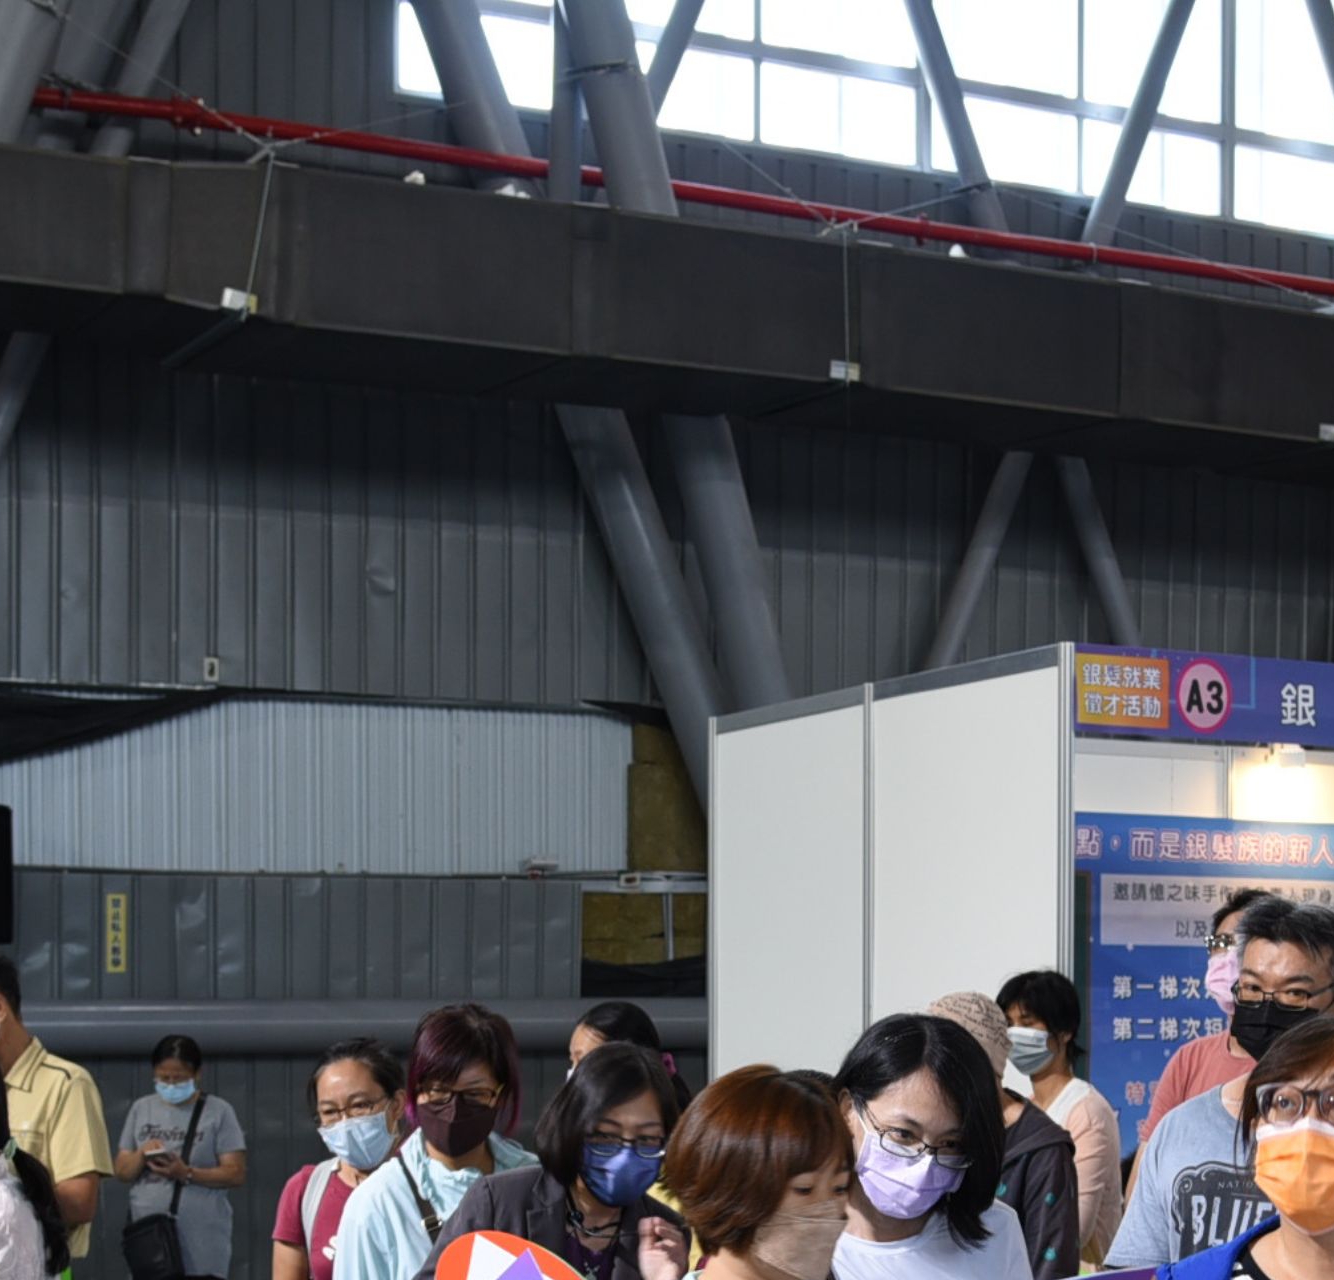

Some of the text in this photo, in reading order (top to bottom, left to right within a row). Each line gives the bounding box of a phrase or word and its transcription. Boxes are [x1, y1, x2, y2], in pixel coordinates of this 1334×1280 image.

[1082, 663, 1161, 690] 銀髮就業
[1083, 692, 1161, 719] 徵才活動
[1185, 679, 1224, 715] A3
